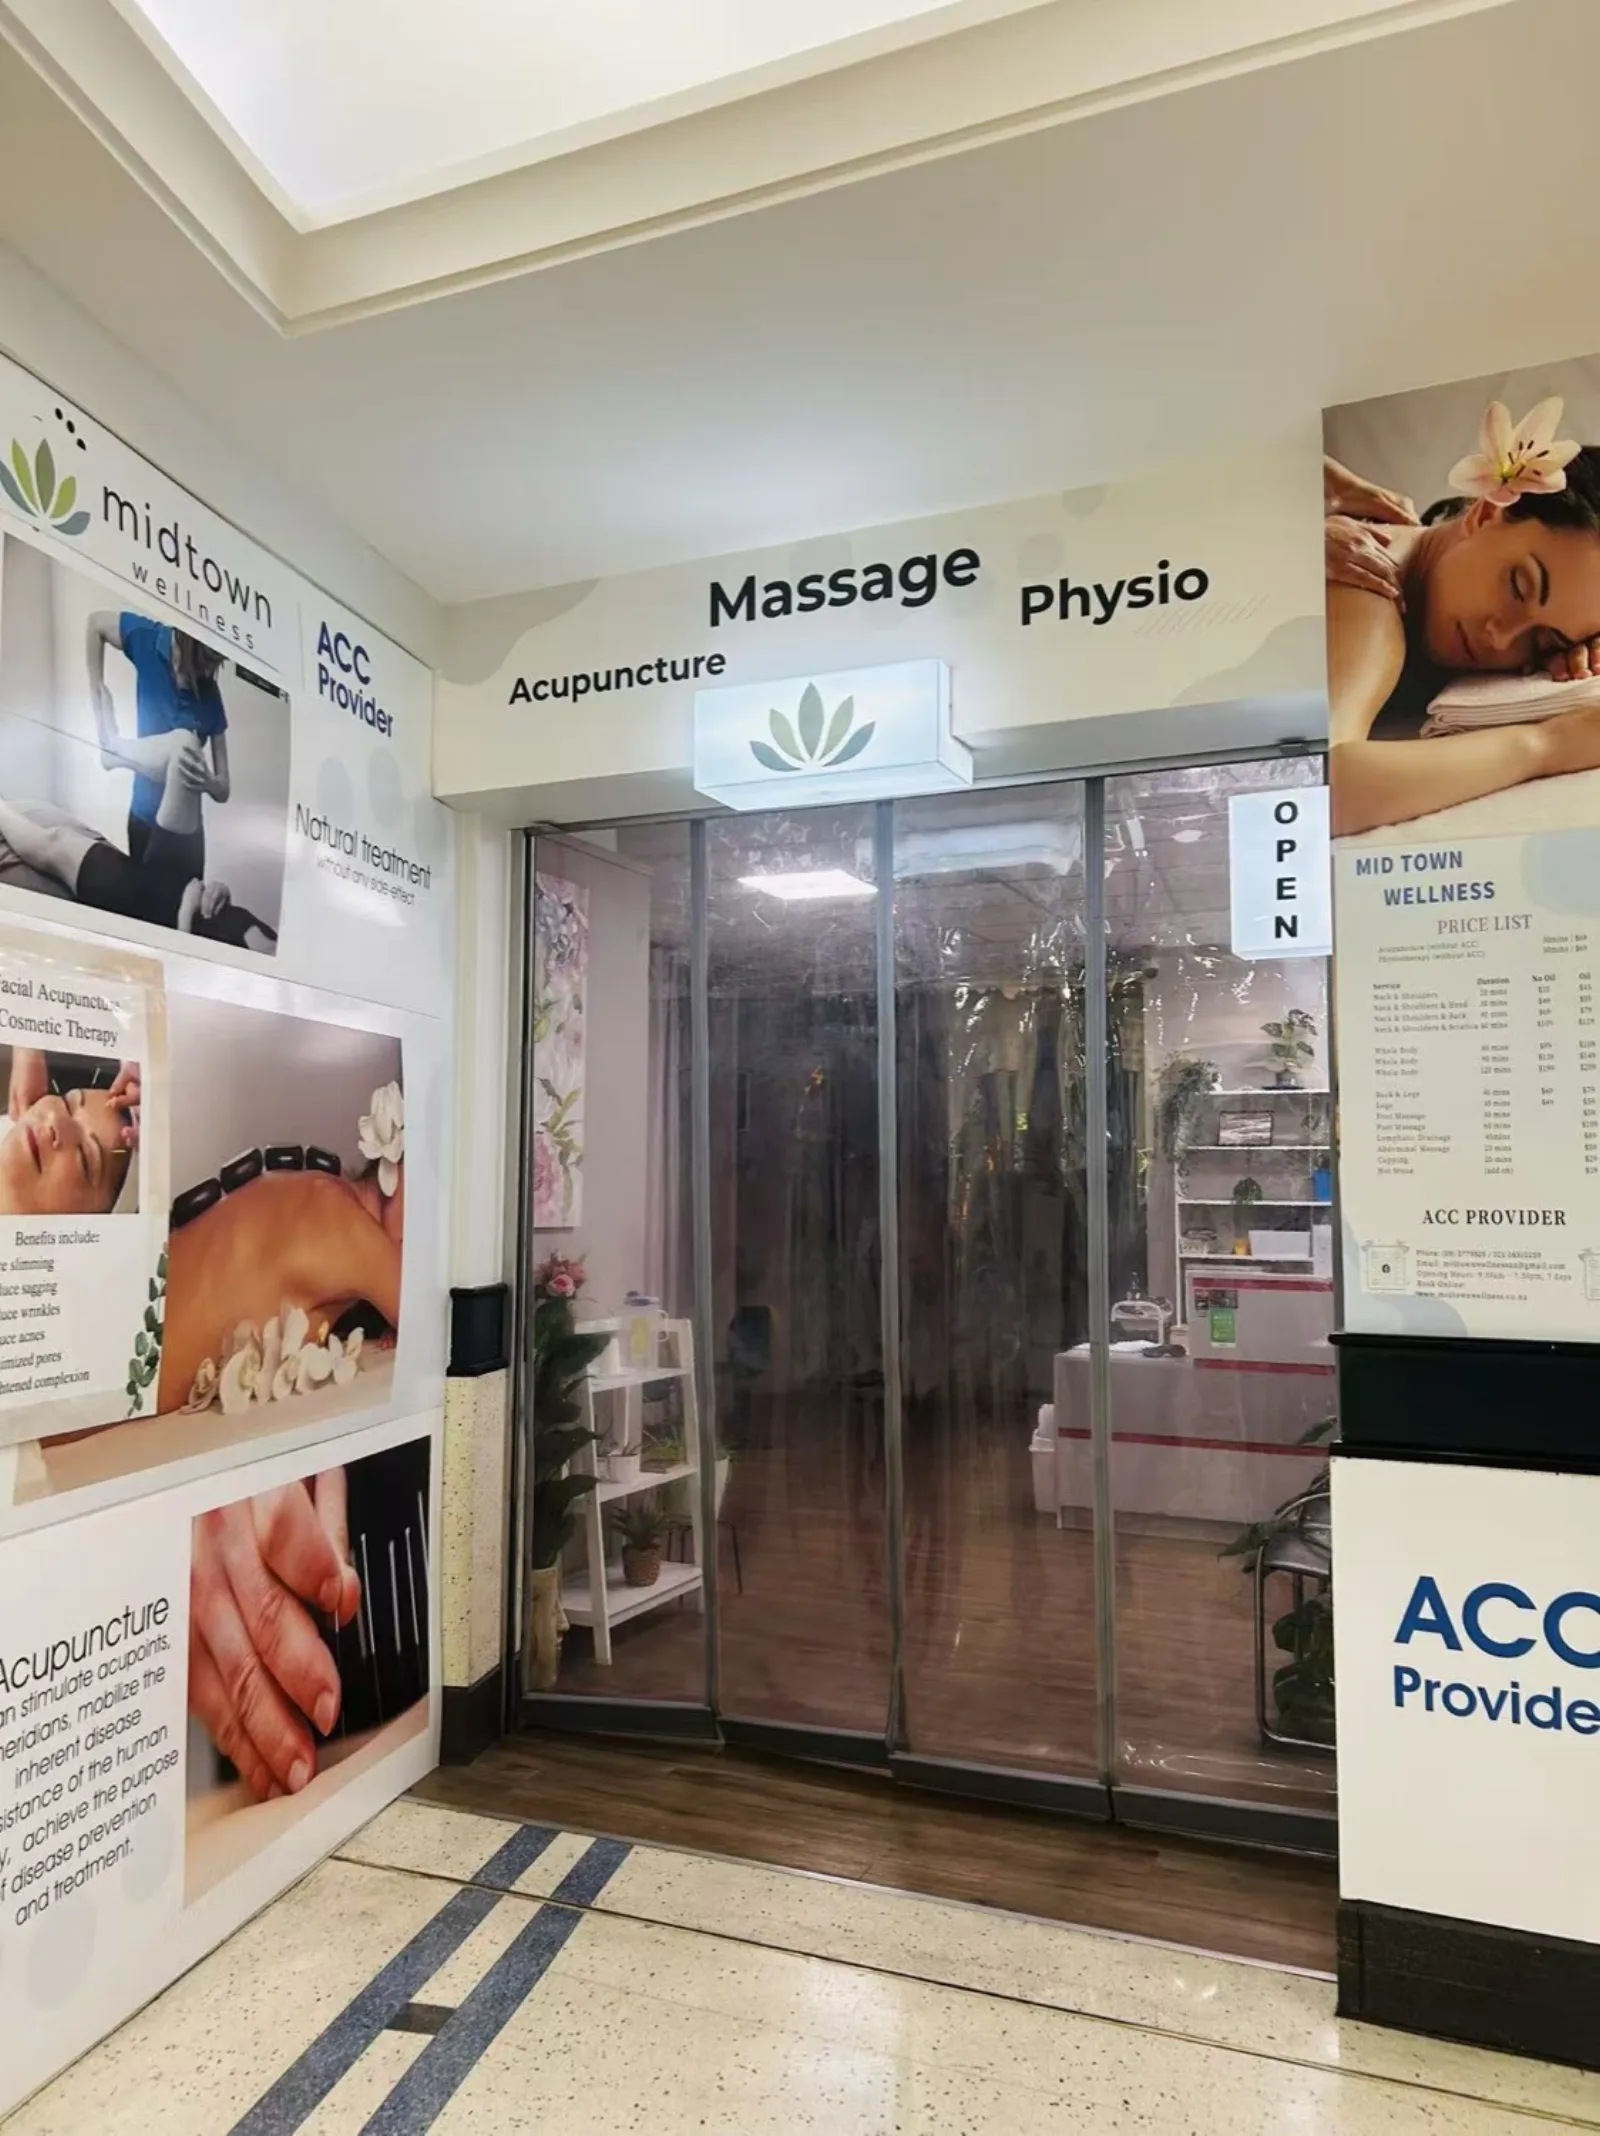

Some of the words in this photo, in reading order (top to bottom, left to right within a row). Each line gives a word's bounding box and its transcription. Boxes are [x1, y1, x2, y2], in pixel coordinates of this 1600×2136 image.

[102, 485, 274, 630] midtown
[709, 545, 982, 628] Massage
[1020, 558, 1210, 627] Physio
[131, 560, 256, 651] wellness
[317, 621, 371, 686] ACC
[507, 648, 727, 706] Acupuncture
[317, 667, 394, 739] Provider
[295, 802, 358, 858] Natural
[361, 833, 432, 890] treatment
[1355, 856, 1394, 876] MID
[1400, 849, 1464, 873] TOWN
[1273, 800, 1299, 939] OPEN
[1383, 880, 1496, 906] WELLNESS
[1437, 915, 1489, 935] PRICE
[1494, 913, 1533, 931] LIST
[0, 973, 33, 998] acial
[1401, 991, 1439, 1001] Shoulders
[1477, 977, 1510, 986] Duration
[1532, 974, 1543, 983] No
[1543, 972, 1557, 982] Oil
[1401, 1001, 1439, 1011] Shoulders
[1401, 1012, 1440, 1022] Shoulders
[0, 1007, 62, 1036] Cosmetic
[65, 1018, 119, 1048] Therapy
[1402, 1023, 1440, 1033] Shoulders
[1377, 1155, 1410, 1165] Cupping
[1422, 1209, 1459, 1225] ACC
[1466, 1208, 1567, 1226] PROVIDER
[15, 1230, 56, 1246] Benefits
[58, 1230, 101, 1245] include:
[10, 1257, 55, 1273] slimming
[22, 1281, 58, 1297] sagging
[20, 1303, 61, 1319] wrinkles
[18, 1330, 46, 1344] acnes
[35, 1351, 62, 1368] pores
[34, 1369, 90, 1389] complexion
[1393, 1575, 1600, 1669] ACC
[20, 1669, 94, 1718] stimulate
[97, 1633, 171, 1680] acupoints,
[77, 1678, 140, 1723] mobilize
[143, 1665, 166, 1690] the
[15, 1735, 80, 1789] inherent
[84, 1708, 142, 1751] disease
[67, 1765, 84, 1793] of
[88, 1755, 113, 1782] the
[116, 1724, 168, 1767] human
[22, 1800, 89, 1853] achieve
[93, 1783, 118, 1811] the
[121, 1749, 179, 1800] purpose
[11, 1842, 74, 1894] disease
[78, 1792, 157, 1858] prevention
[15, 1885, 50, 1926] and
[54, 1836, 134, 1902] treatment.
